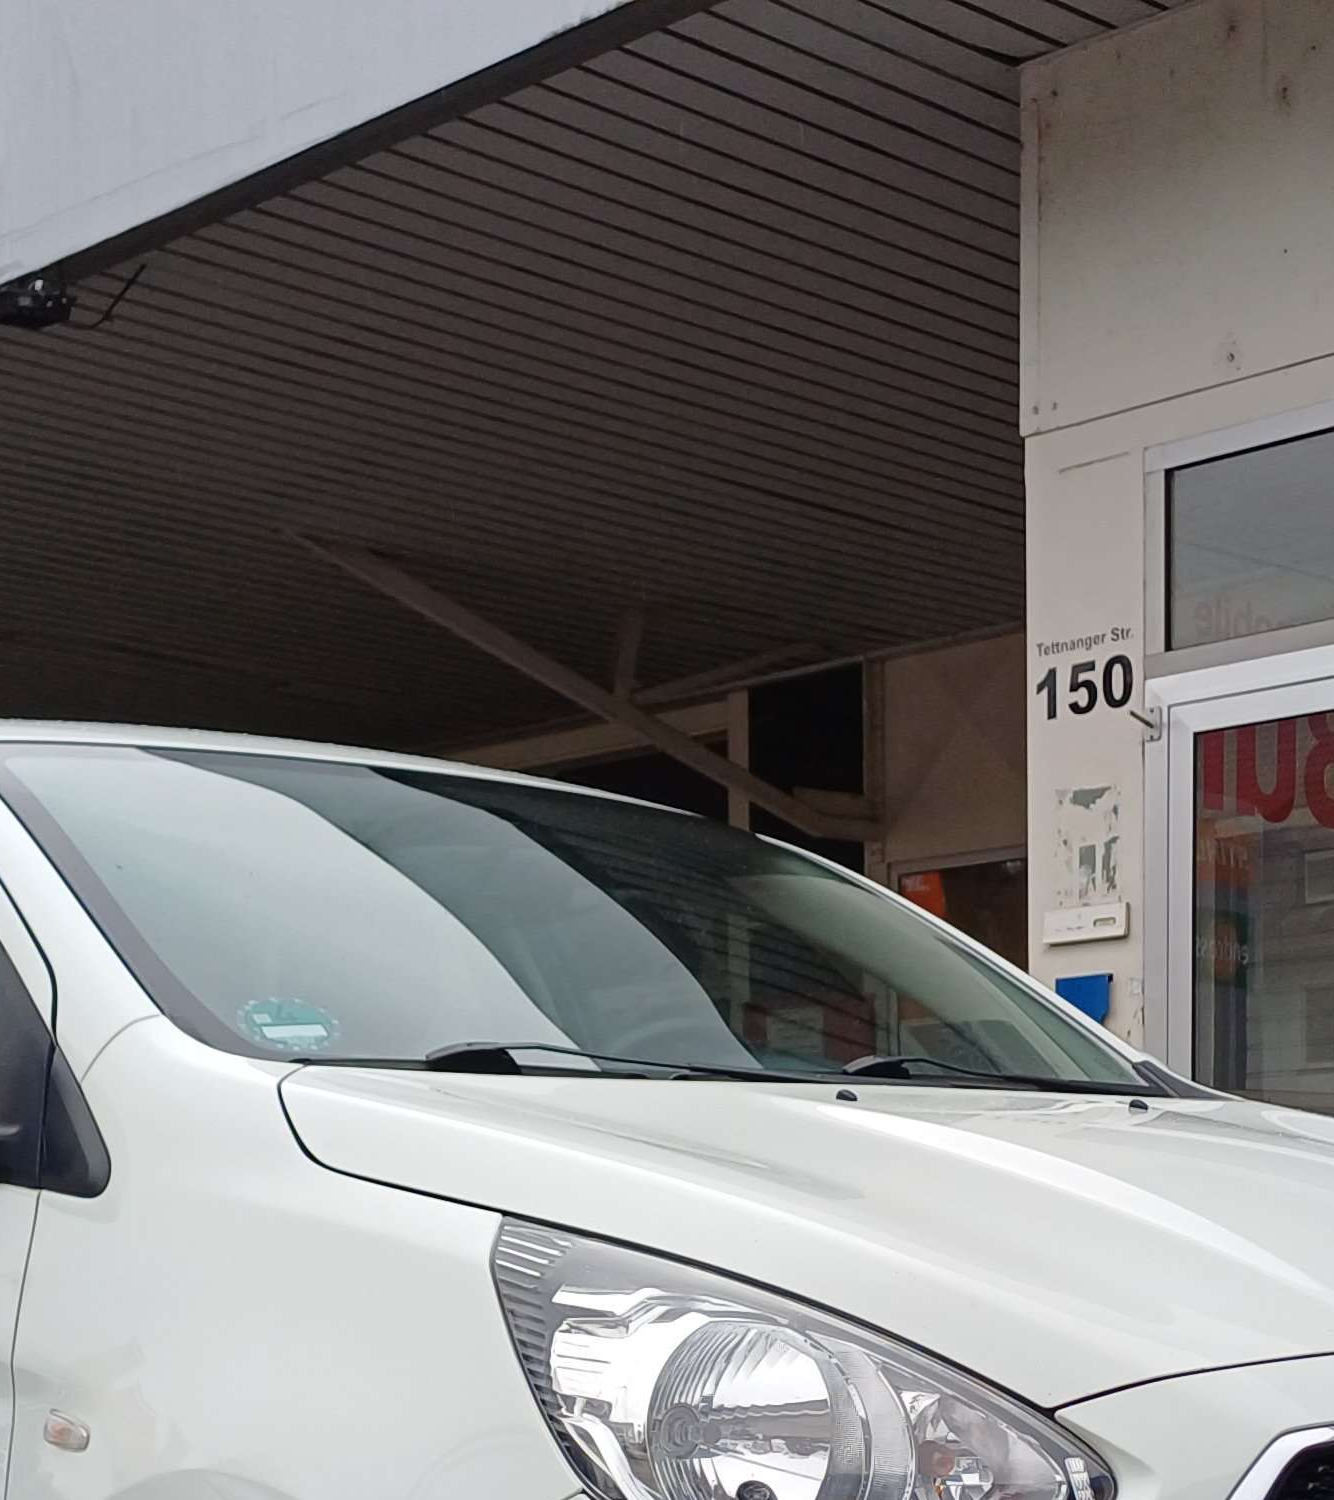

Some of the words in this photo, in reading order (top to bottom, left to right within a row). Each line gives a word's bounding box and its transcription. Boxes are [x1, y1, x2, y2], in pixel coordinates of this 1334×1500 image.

[1036, 633, 1107, 657] Tettnanger
[1110, 627, 1135, 642] Str.
[1036, 654, 1133, 720] 150
